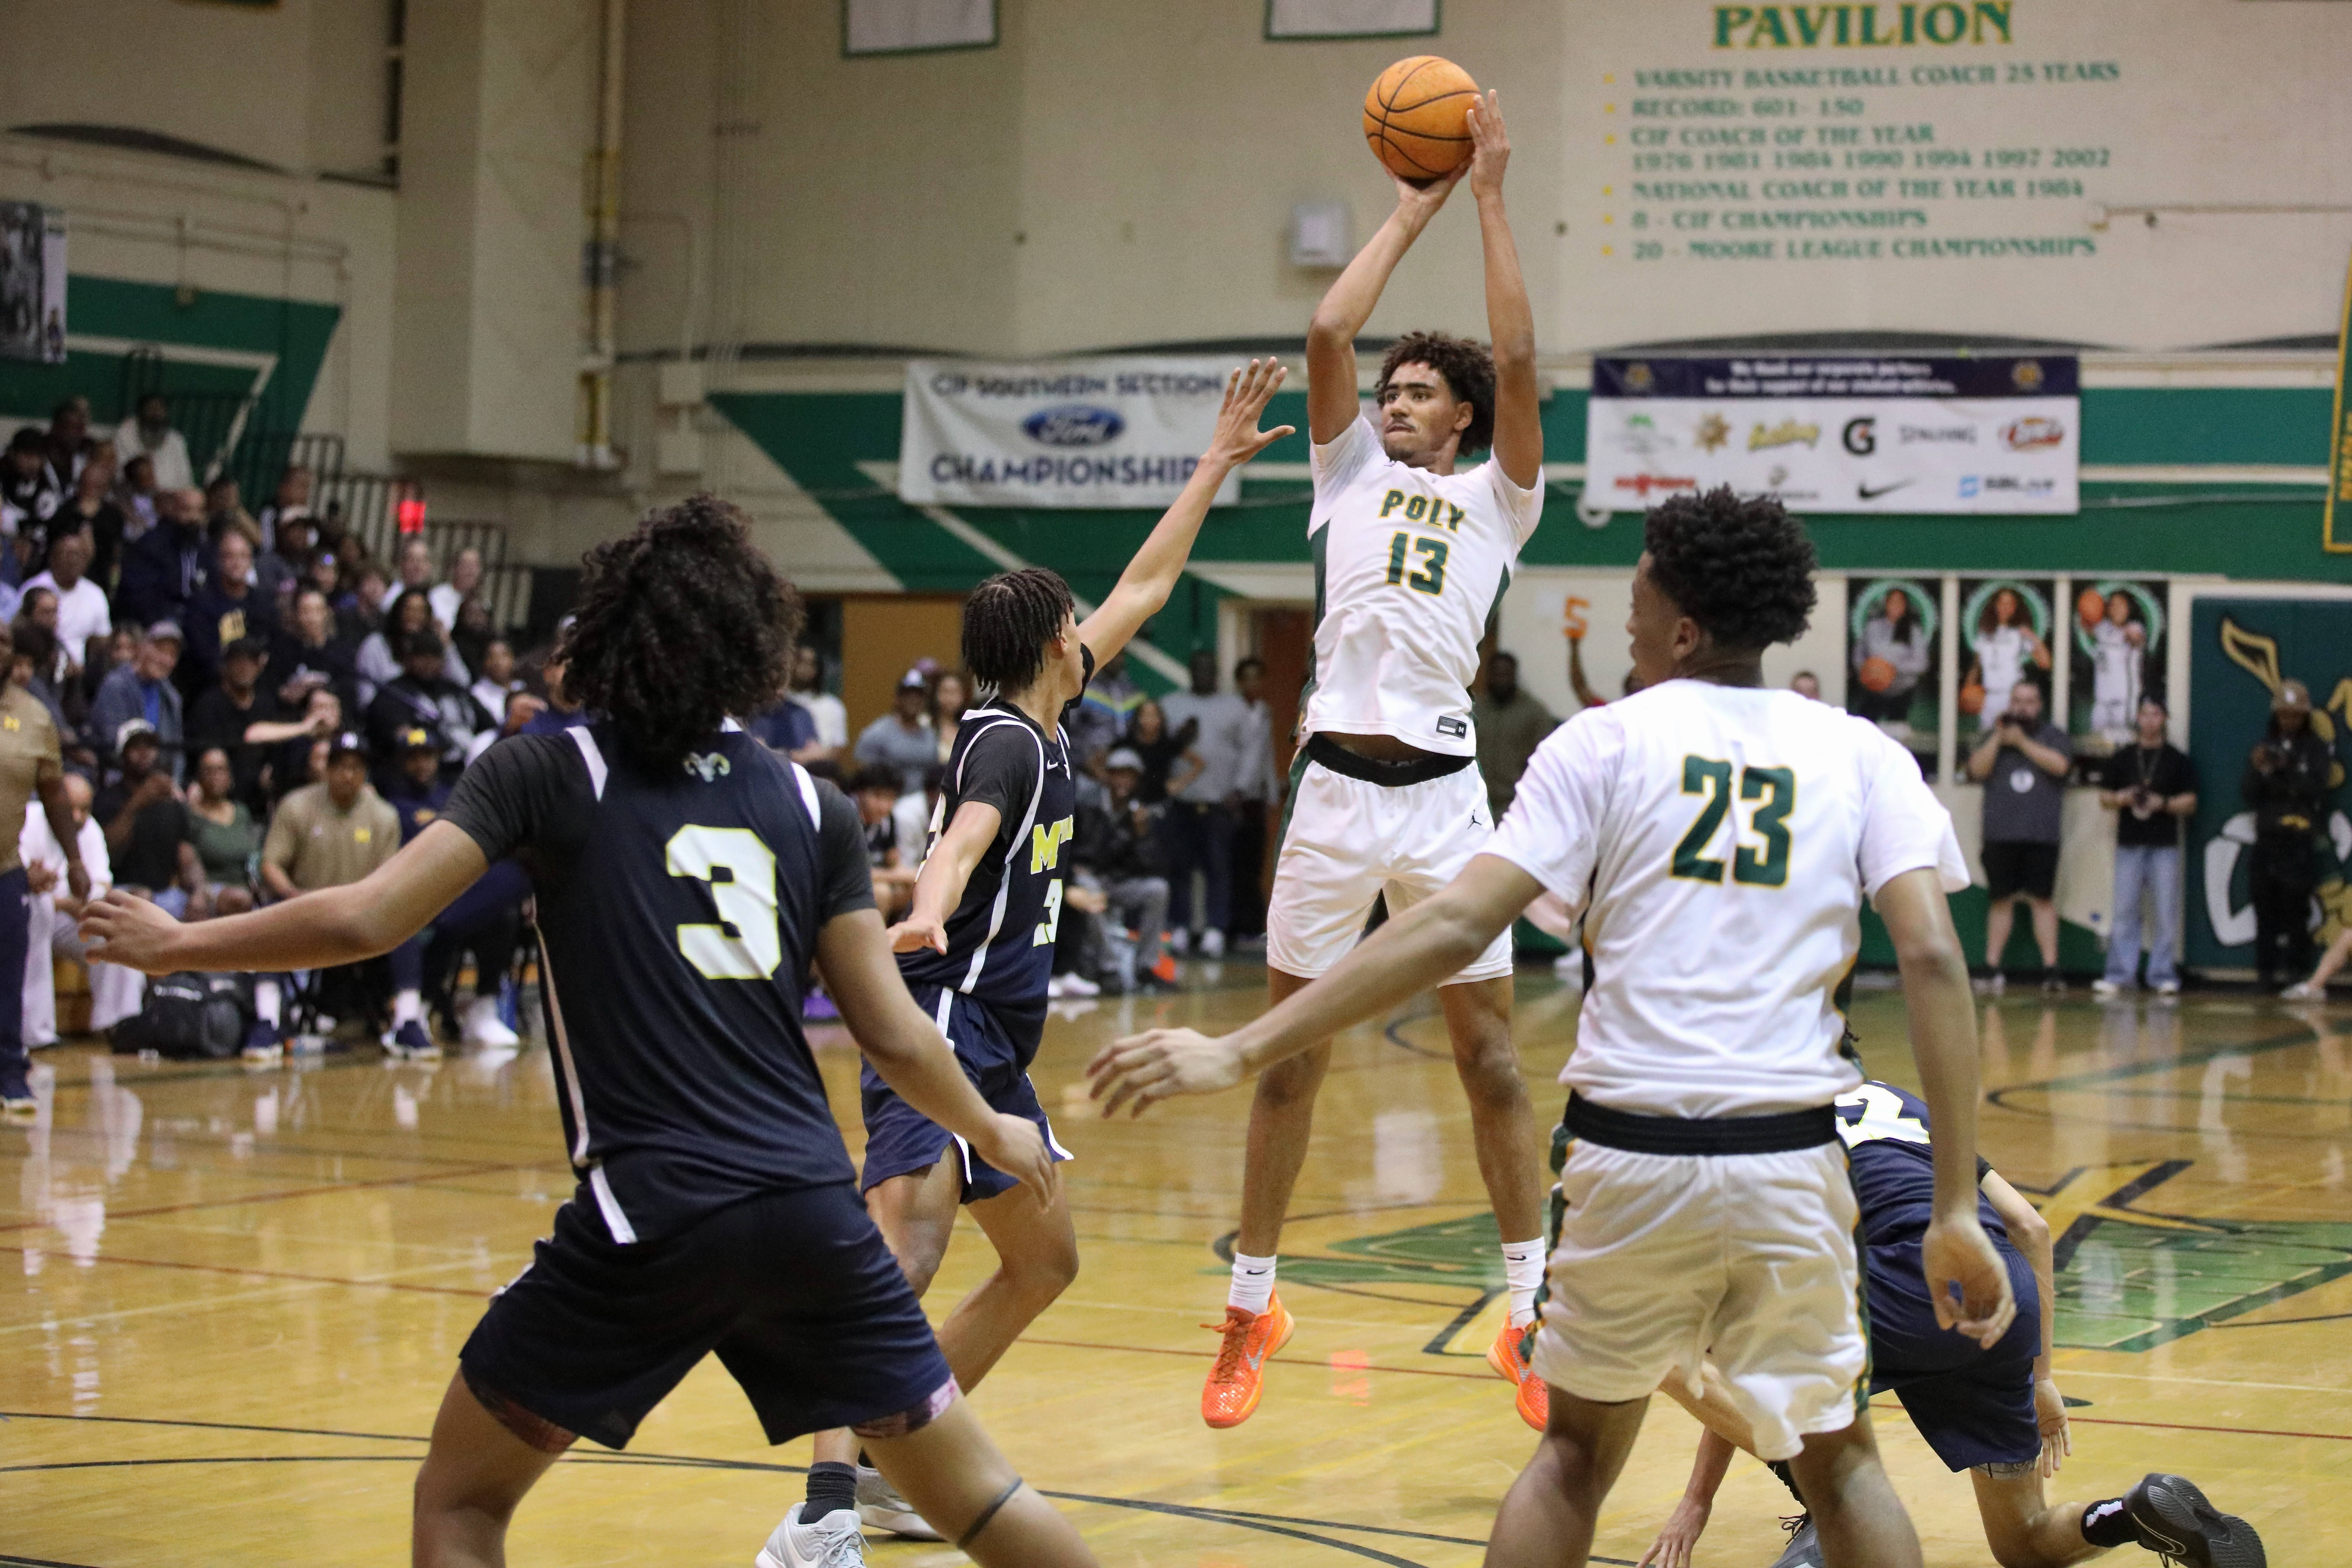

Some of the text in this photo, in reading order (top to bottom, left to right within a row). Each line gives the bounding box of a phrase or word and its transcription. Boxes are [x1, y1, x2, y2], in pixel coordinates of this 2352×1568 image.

[1712, 1, 2014, 48] PAVILION
[1634, 68, 1733, 89] VARSITY
[1744, 67, 1899, 87] BASKETBALL
[1910, 64, 1996, 85] COACH
[2042, 62, 2120, 81] YEARS
[1632, 97, 1743, 117] RECORD:
[1630, 123, 1934, 145] CIF COACH OF THE YEAR
[1632, 181, 1749, 199] NATIONAL
[1761, 181, 1848, 198] COACH
[1856, 179, 1886, 197] OF
[1899, 179, 1942, 197] THE
[1954, 178, 2016, 197] YEAR
[1672, 209, 1712, 229] CIF
[1720, 207, 1928, 229] CHAMPIONSHIPS
[1688, 239, 1775, 260] MOORE
[1787, 239, 1882, 259] LEAGUE
[1891, 236, 2097, 258] CHAMPIONSHIPS
[1115, 371, 1223, 397] SECTION
[1842, 417, 1877, 456] G
[930, 453, 1201, 486] CHAMPIONSHIP
[1378, 488, 1466, 534] POLY
[1385, 530, 1450, 597] 13
[1669, 752, 1797, 890] 23
[665, 824, 781, 980] 3
